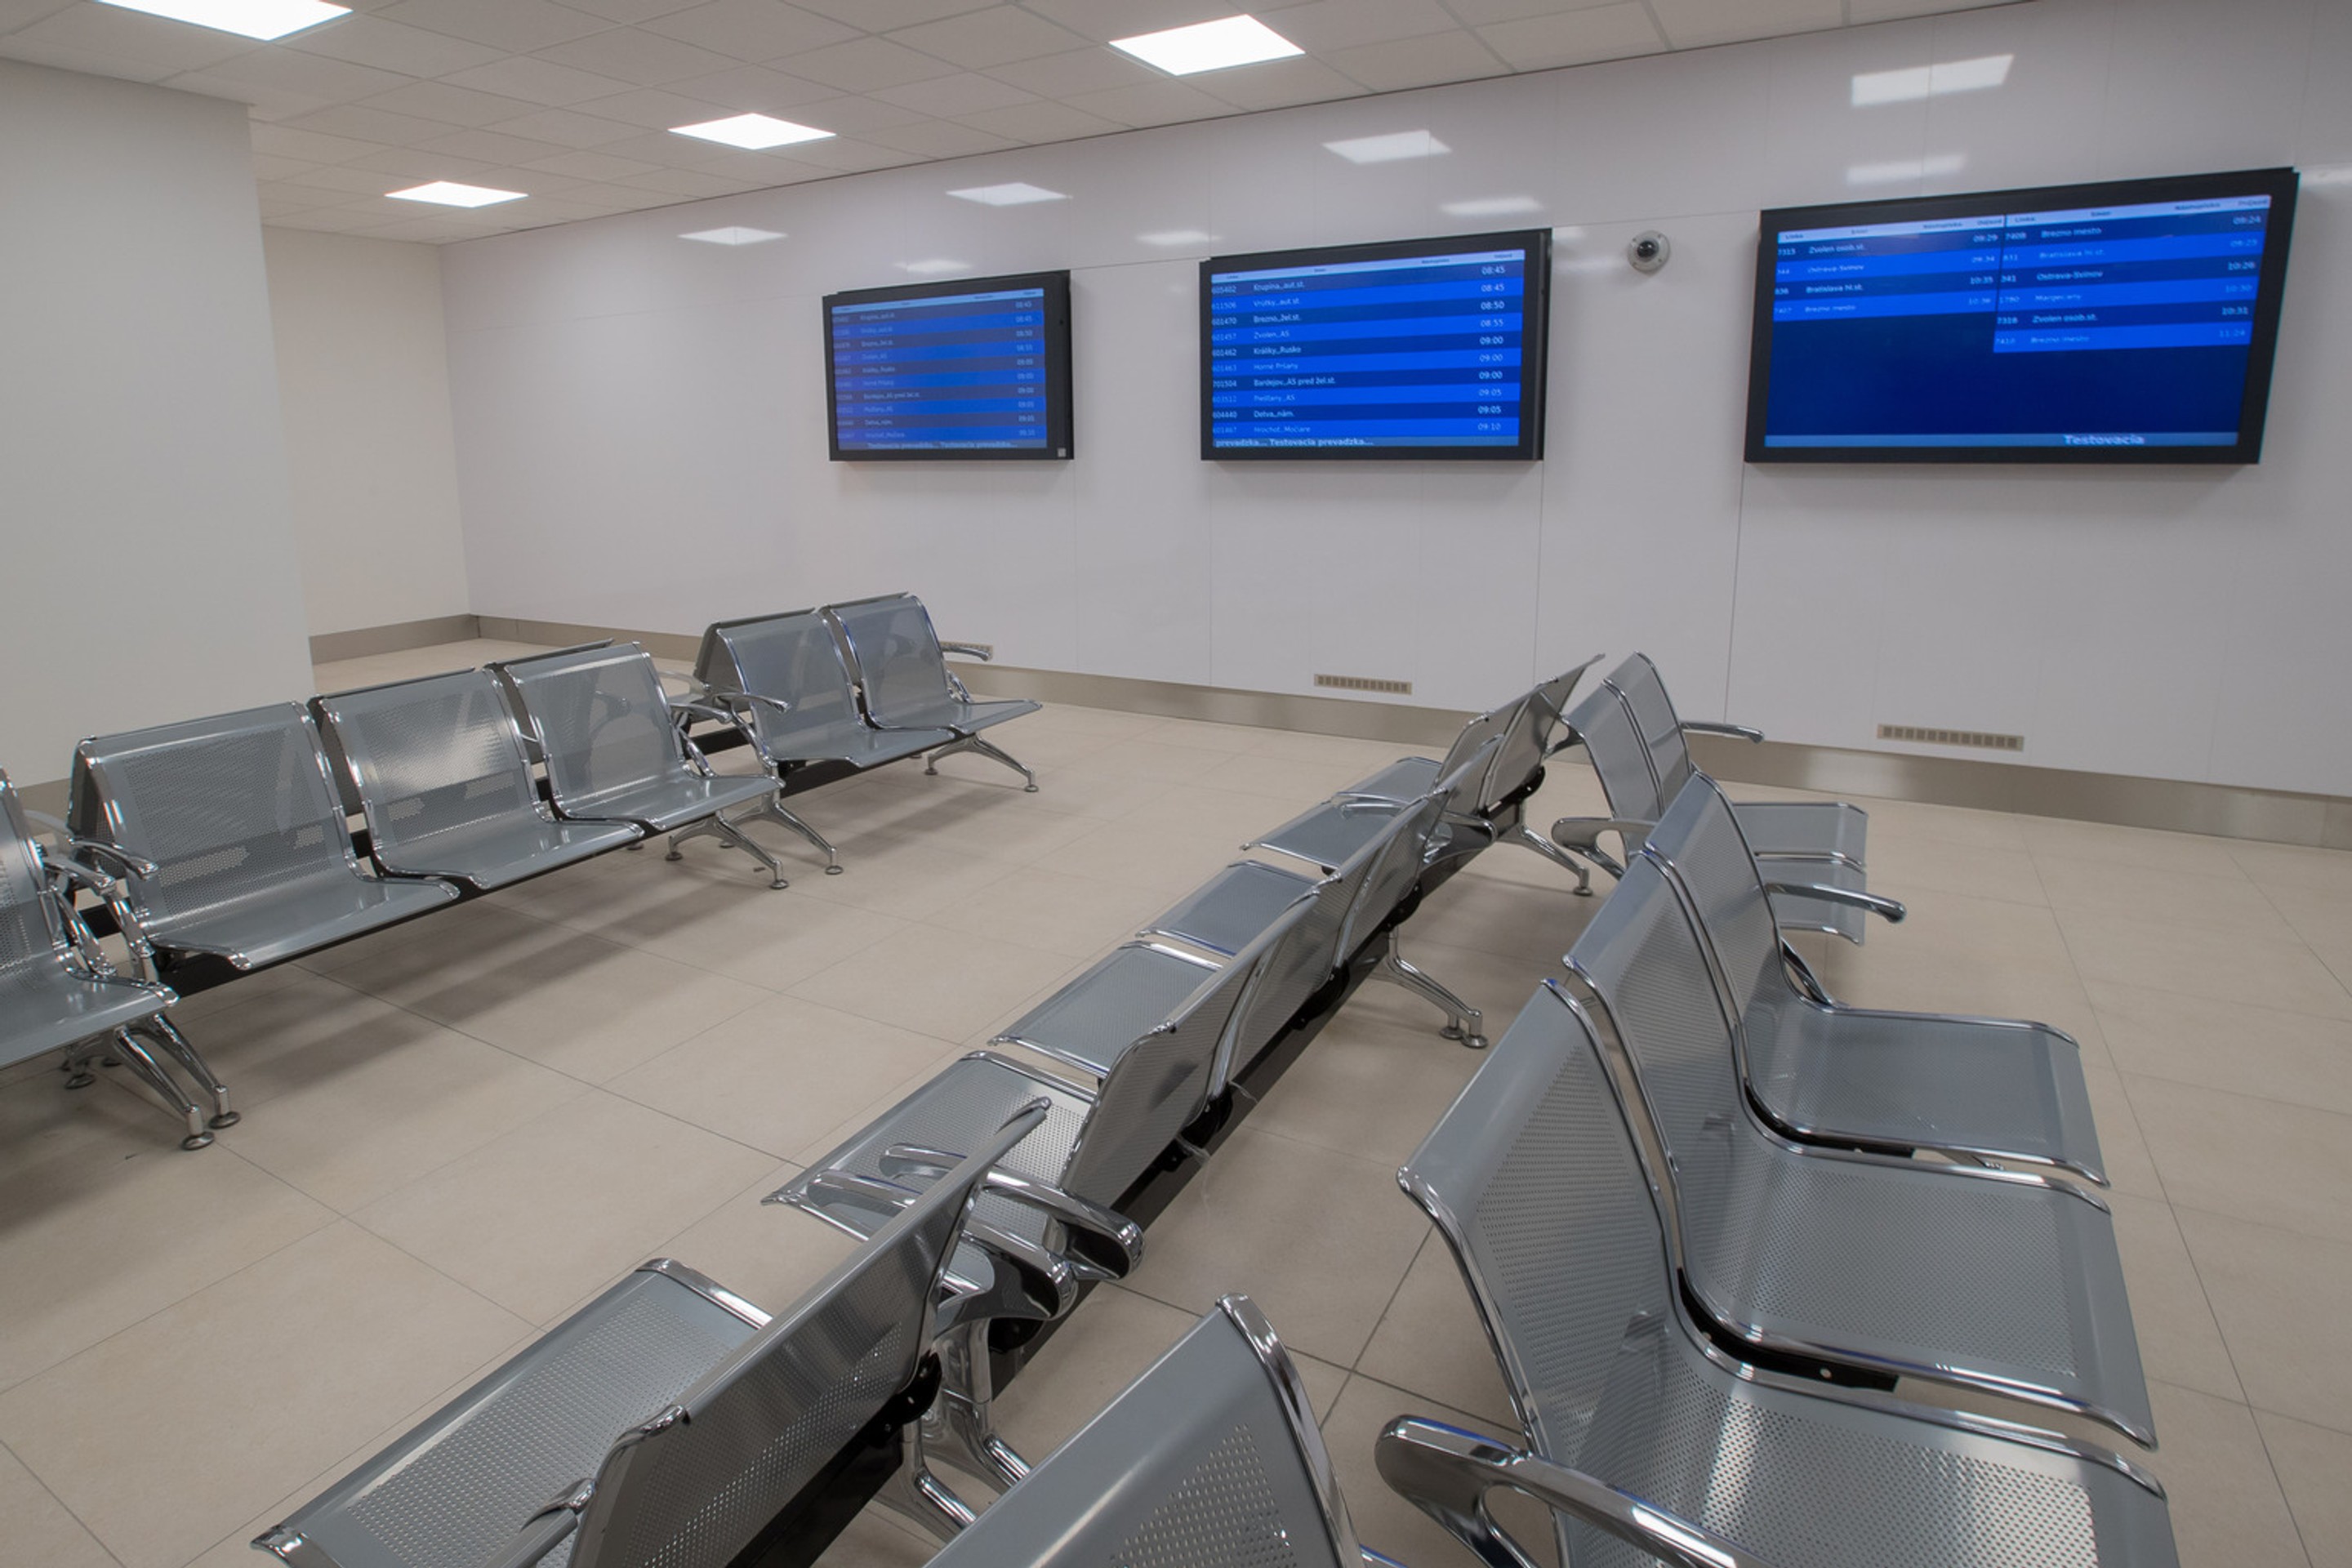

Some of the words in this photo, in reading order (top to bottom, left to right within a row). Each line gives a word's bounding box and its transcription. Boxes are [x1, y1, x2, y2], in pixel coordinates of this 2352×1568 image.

[2041, 229, 2072, 238] Brezno
[2074, 228, 2102, 236] mesto
[1481, 266, 1506, 275] 08:45
[1481, 283, 1505, 292] 08:45
[1481, 301, 1505, 310] 08:50
[1480, 318, 1503, 327] 08:55
[1479, 336, 1503, 345] 09:00
[1479, 354, 1503, 363] 09:00
[1478, 371, 1503, 380] 09:00
[1477, 405, 1502, 415] 09:05
[1268, 439, 1316, 448] Testovacia
[2062, 434, 2146, 446] Testovacia
